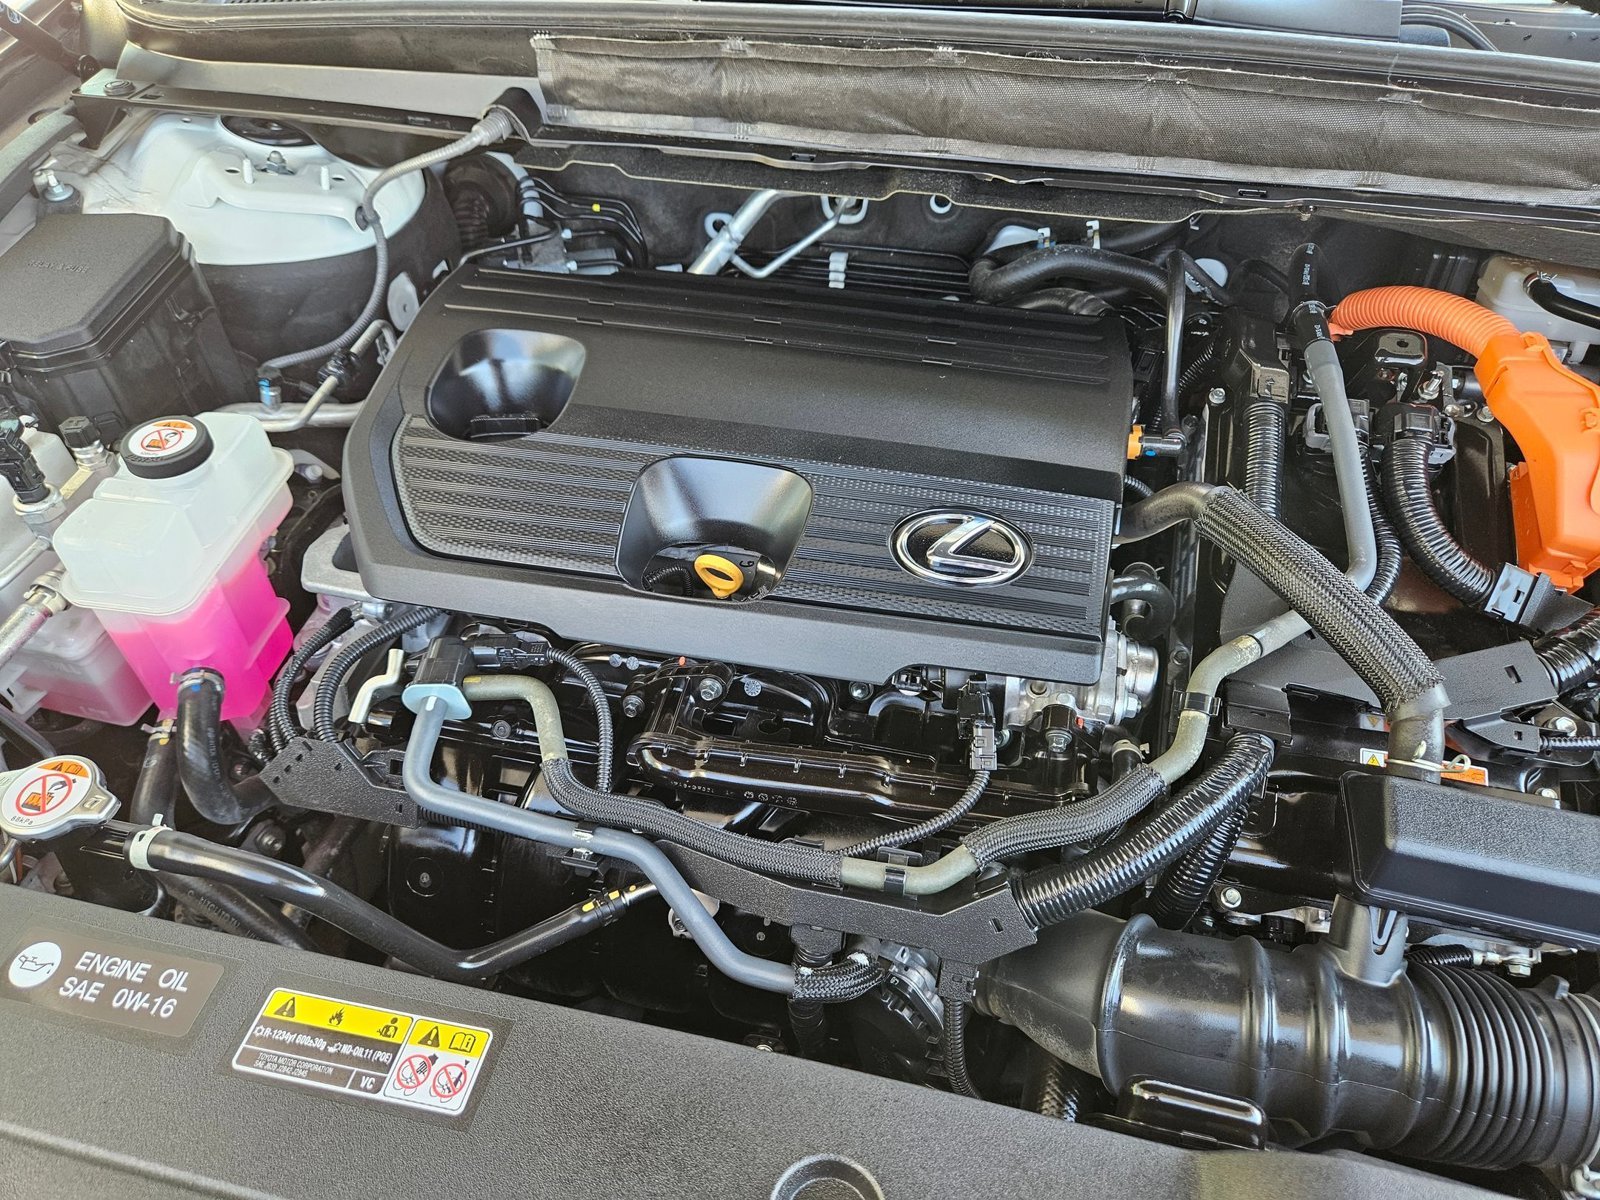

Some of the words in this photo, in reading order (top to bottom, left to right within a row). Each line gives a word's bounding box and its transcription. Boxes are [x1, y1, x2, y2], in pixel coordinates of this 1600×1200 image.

[74, 951, 152, 983] ENGINE
[158, 968, 189, 992] OIL
[59, 976, 105, 1003] SAE
[111, 988, 178, 1019] 0W-16
[258, 1052, 279, 1063] TOYOTA
[277, 1056, 298, 1067] MOTOR
[296, 1060, 335, 1075] CORPORATION
[360, 1076, 376, 1089] VC
